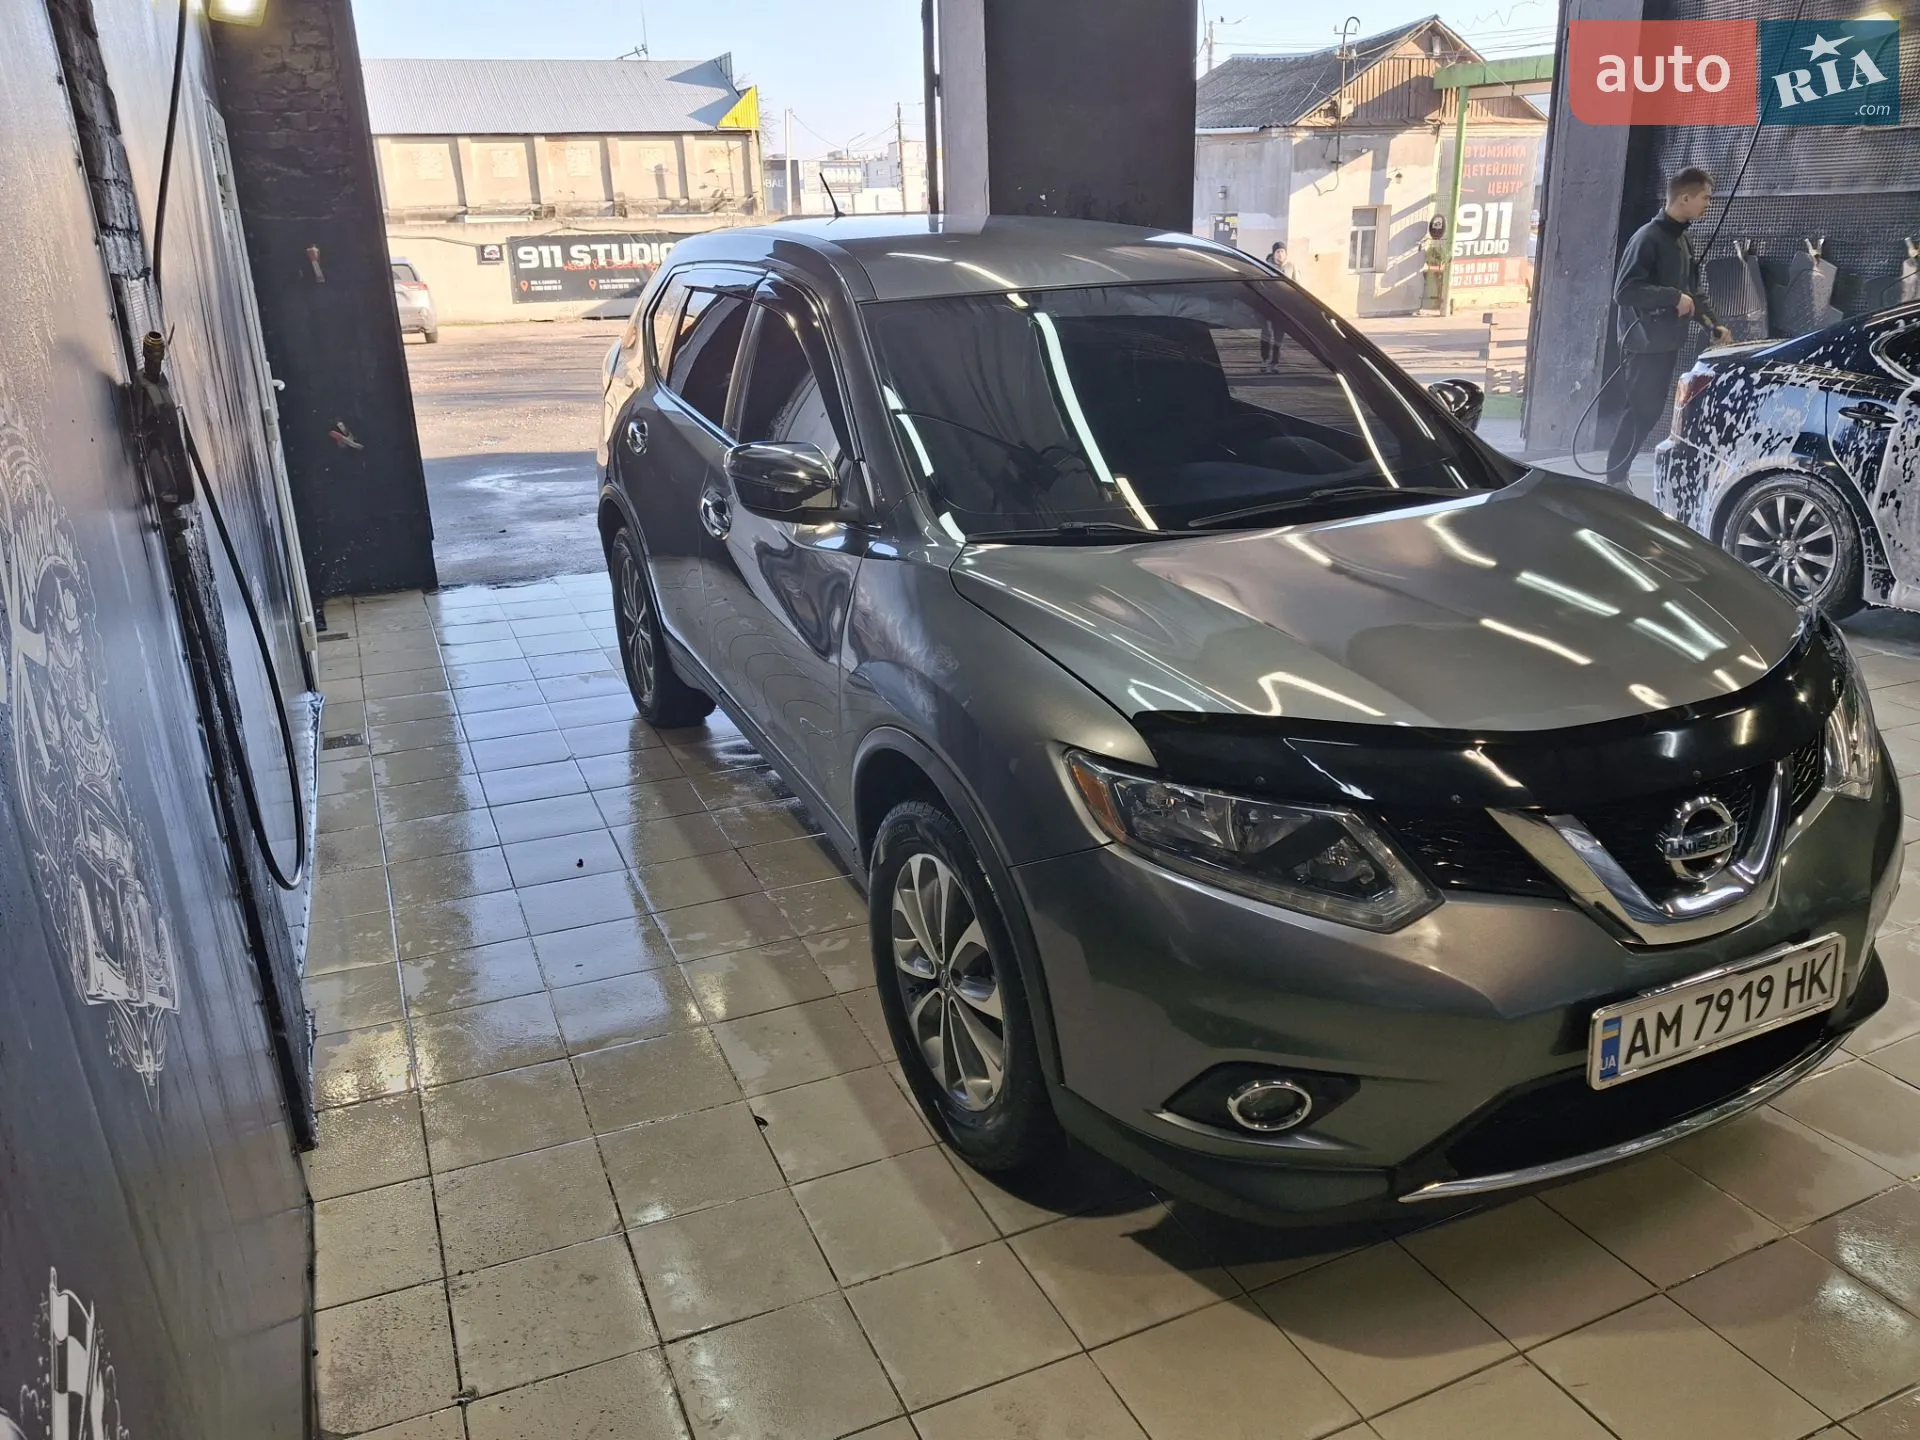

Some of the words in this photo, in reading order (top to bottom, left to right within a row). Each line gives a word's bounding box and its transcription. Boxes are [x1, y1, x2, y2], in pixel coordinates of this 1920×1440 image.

[1487, 181, 1524, 197] ЦЕНТР
[1455, 201, 1514, 241] 911
[517, 244, 563, 269] 911
[1453, 239, 1510, 257] STUDIO
[1679, 829, 1736, 855] NISSAN
[1624, 1004, 1683, 1065] AM
[1694, 974, 1775, 1041] 7919
[1783, 952, 1832, 1009] HK
[1600, 1055, 1616, 1071] UA
